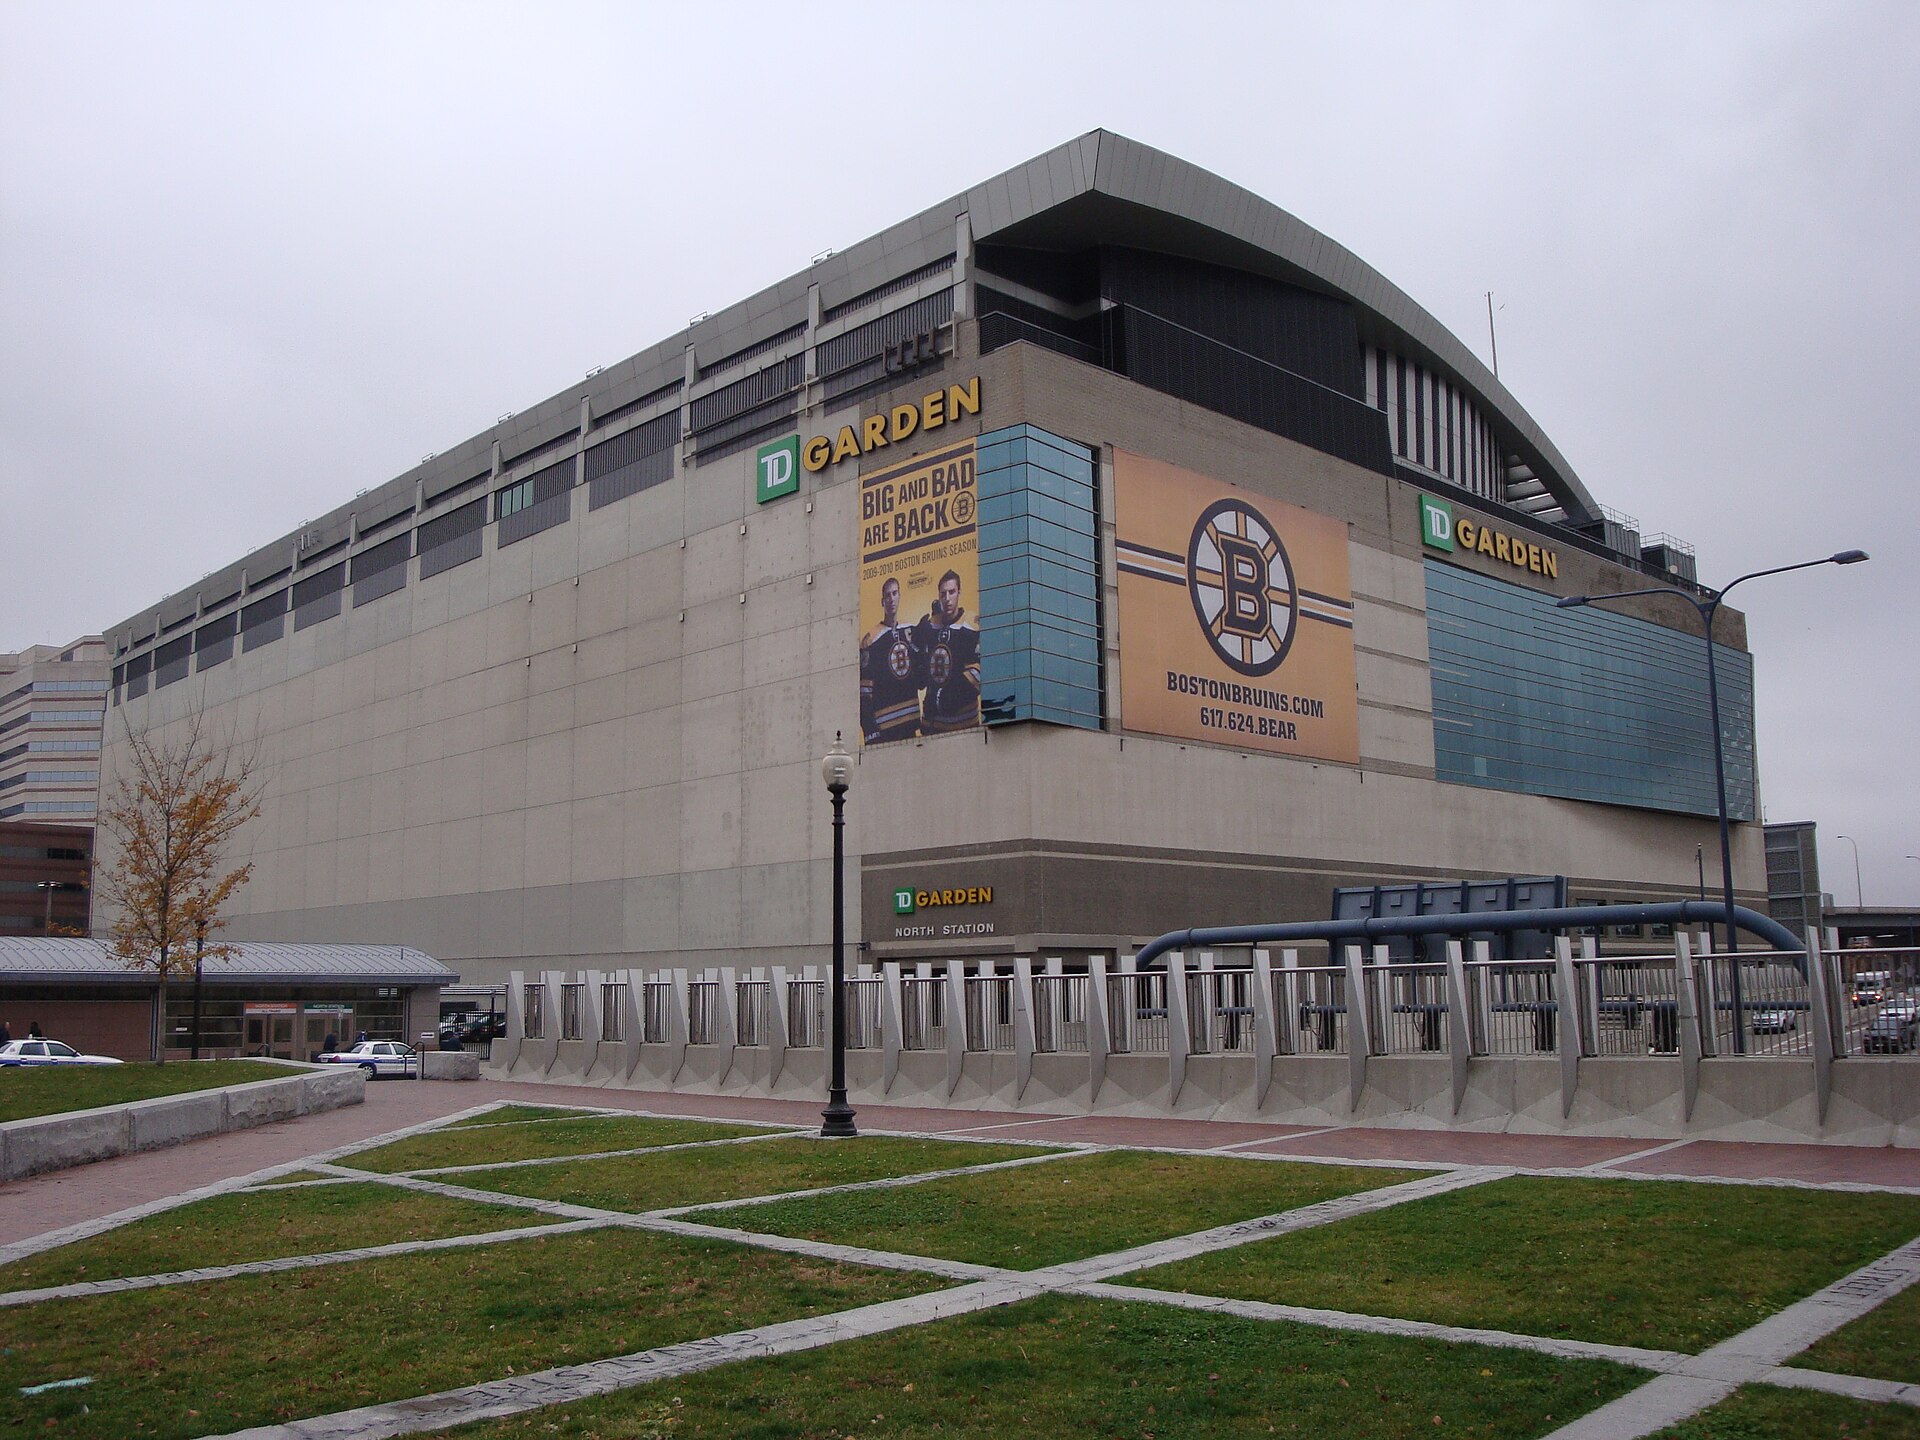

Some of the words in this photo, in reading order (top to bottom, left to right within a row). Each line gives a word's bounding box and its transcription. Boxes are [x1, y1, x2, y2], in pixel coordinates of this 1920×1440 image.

[761, 449, 792, 488] TD
[803, 376, 981, 472] GARDEN
[863, 484, 894, 520] BIG
[898, 477, 928, 505] AND
[932, 457, 975, 498] BAD
[863, 521, 889, 548] ARE
[894, 499, 949, 542] BACK
[1426, 505, 1450, 540] TD
[1457, 519, 1557, 578] GARDEN
[863, 563, 894, 580] 2009-2010
[895, 554, 920, 572] BOSTON
[922, 547, 948, 564] BRUINS
[949, 538, 977, 557] SEASON
[1217, 531, 1271, 640] B
[1167, 671, 1324, 718] BOSTONBRUINS.COM
[1201, 710, 1297, 740] 617.624.BEAR
[896, 892, 911, 908] TD
[916, 886, 993, 907] GARDEN
[895, 926, 934, 937] NORTH
[943, 923, 994, 935] STATION
[592, 1333, 759, 1370] CANAL
